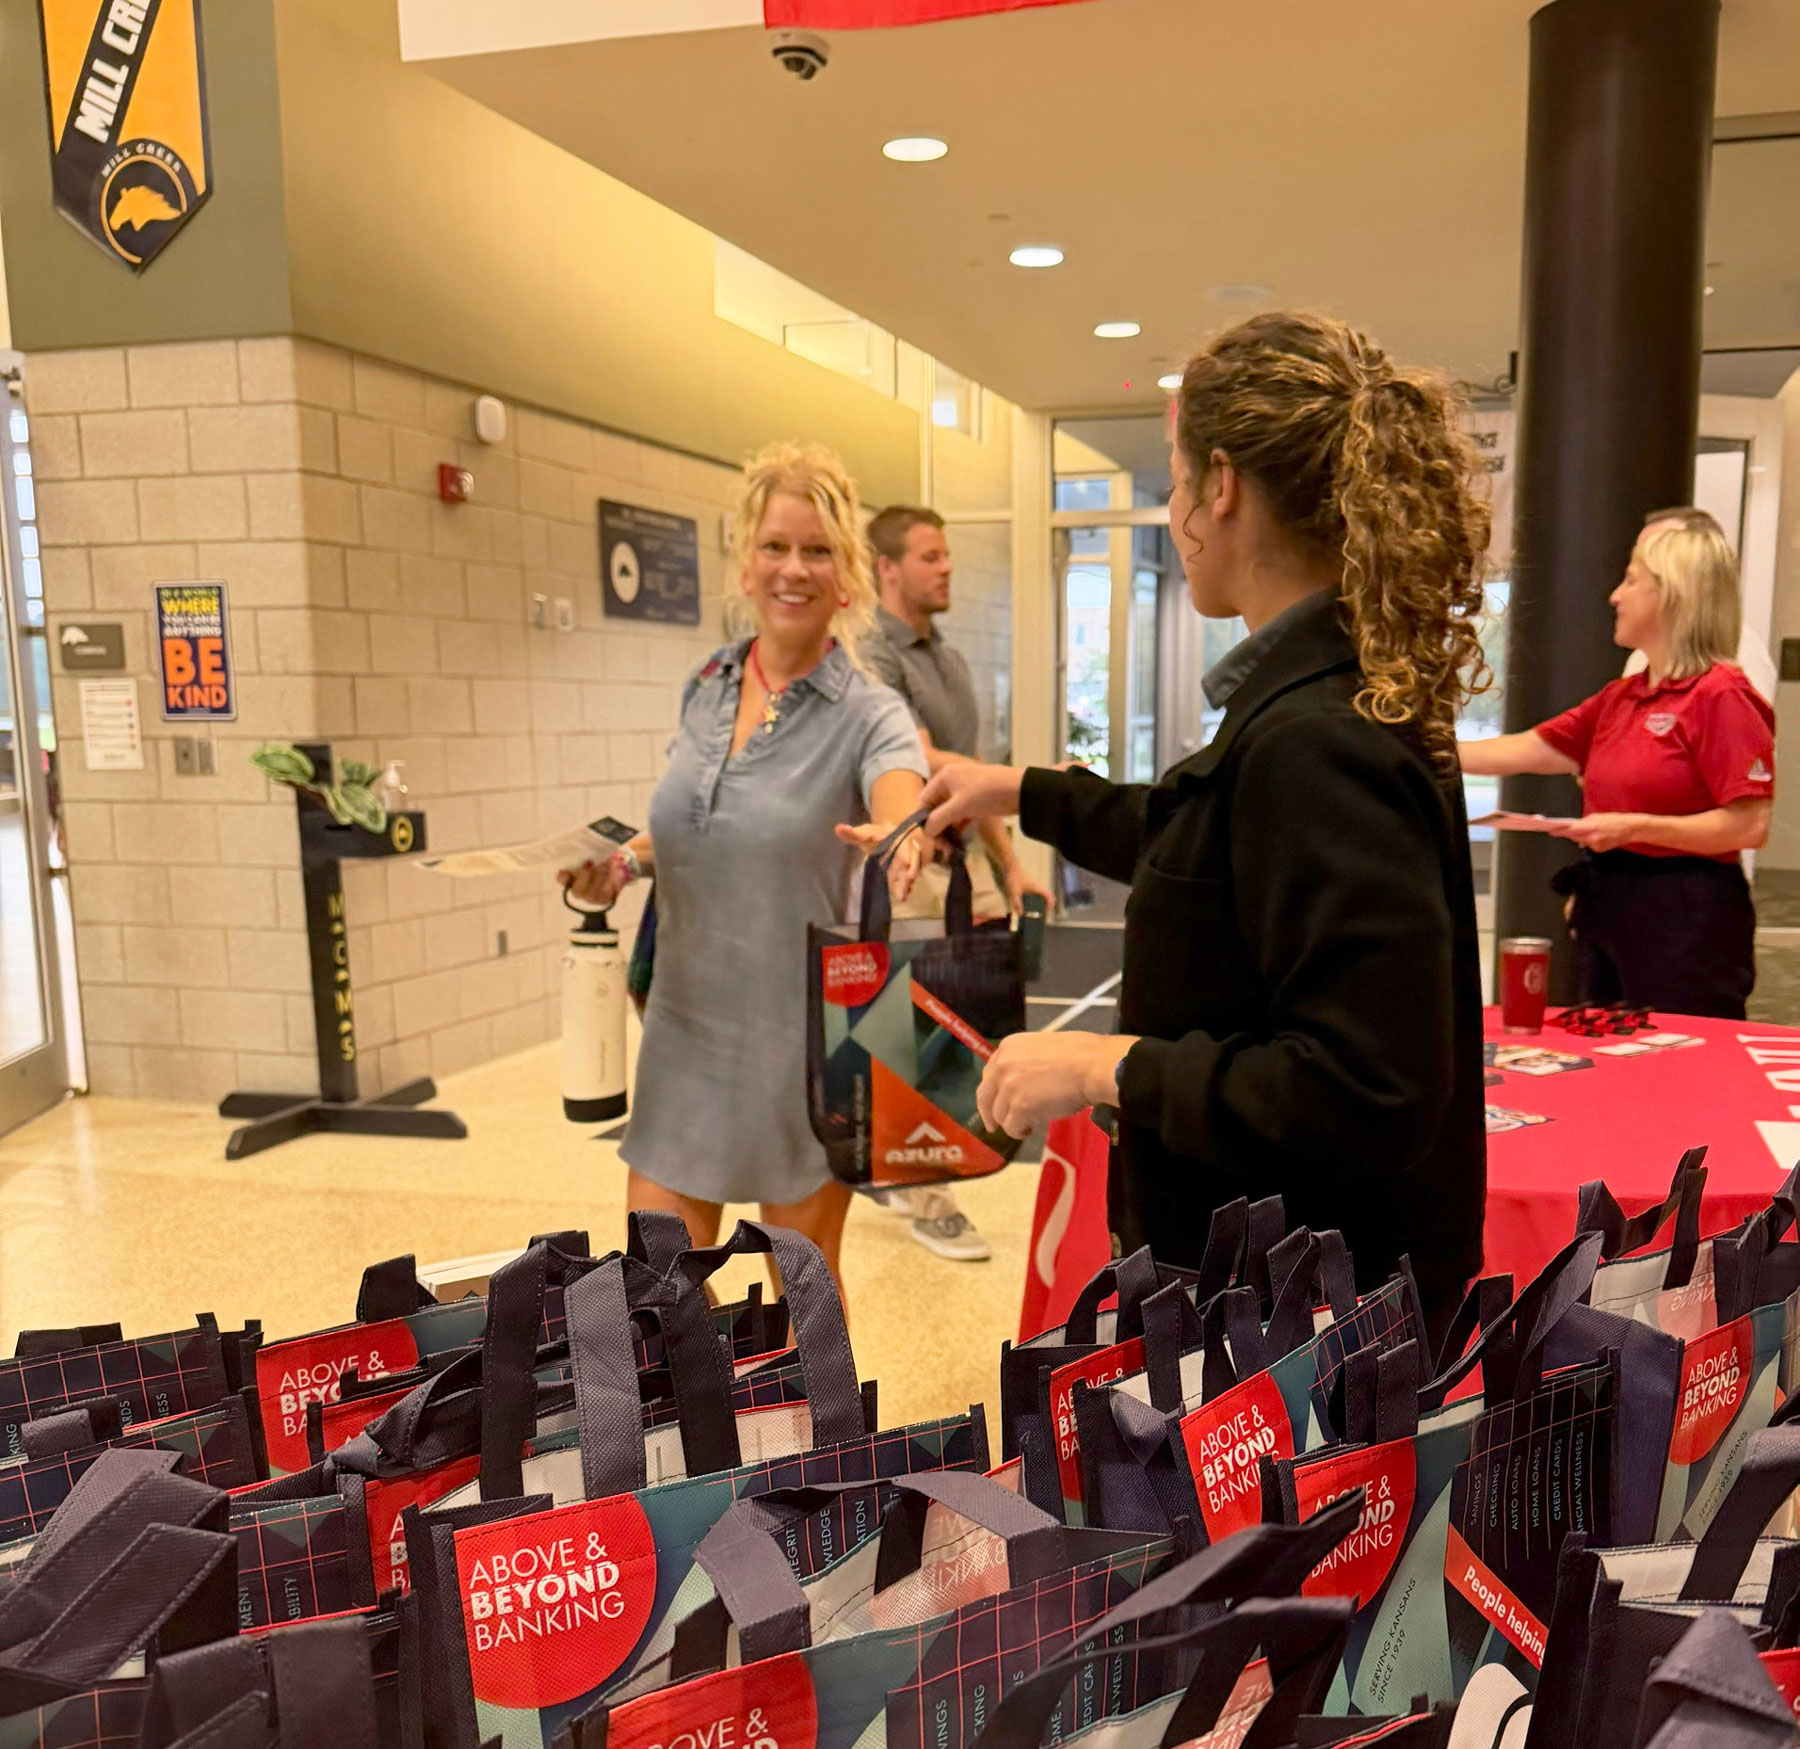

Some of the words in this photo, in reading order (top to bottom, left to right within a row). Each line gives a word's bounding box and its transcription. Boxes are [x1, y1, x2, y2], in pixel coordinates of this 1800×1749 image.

[74, 58, 130, 143] MILL
[163, 638, 226, 686] BE
[167, 686, 228, 709] KIND
[368, 1351, 385, 1371] &
[1686, 1351, 1728, 1389] ABOVE
[1729, 1346, 1739, 1365] &
[1681, 1387, 1737, 1431] BANKING
[1683, 1366, 1740, 1409] BEYOND
[1201, 1412, 1250, 1464] ABOVE
[1252, 1405, 1265, 1426] &
[1203, 1426, 1276, 1488] BEYOND
[1553, 1438, 1563, 1477] CARDS
[1512, 1455, 1521, 1495] LOANS
[1532, 1446, 1541, 1487] LOANS
[1574, 1431, 1584, 1491] WELLNESS
[1378, 1475, 1391, 1499] &
[1490, 1463, 1501, 1528] CHECKING
[1532, 1490, 1540, 1527] HOME
[1552, 1481, 1561, 1521] CREDIT
[469, 1538, 576, 1589] ABOVE
[586, 1532, 608, 1560] &
[470, 1561, 620, 1621] BEYOND
[1464, 1565, 1507, 1618] People
[475, 1592, 625, 1651] BANKING
[1369, 1640, 1391, 1696] SERVING
[1389, 1578, 1417, 1639] KANSANS
[1377, 1664, 1394, 1704] SINCE
[1393, 1629, 1406, 1661] 1939
[746, 1708, 768, 1736] &
